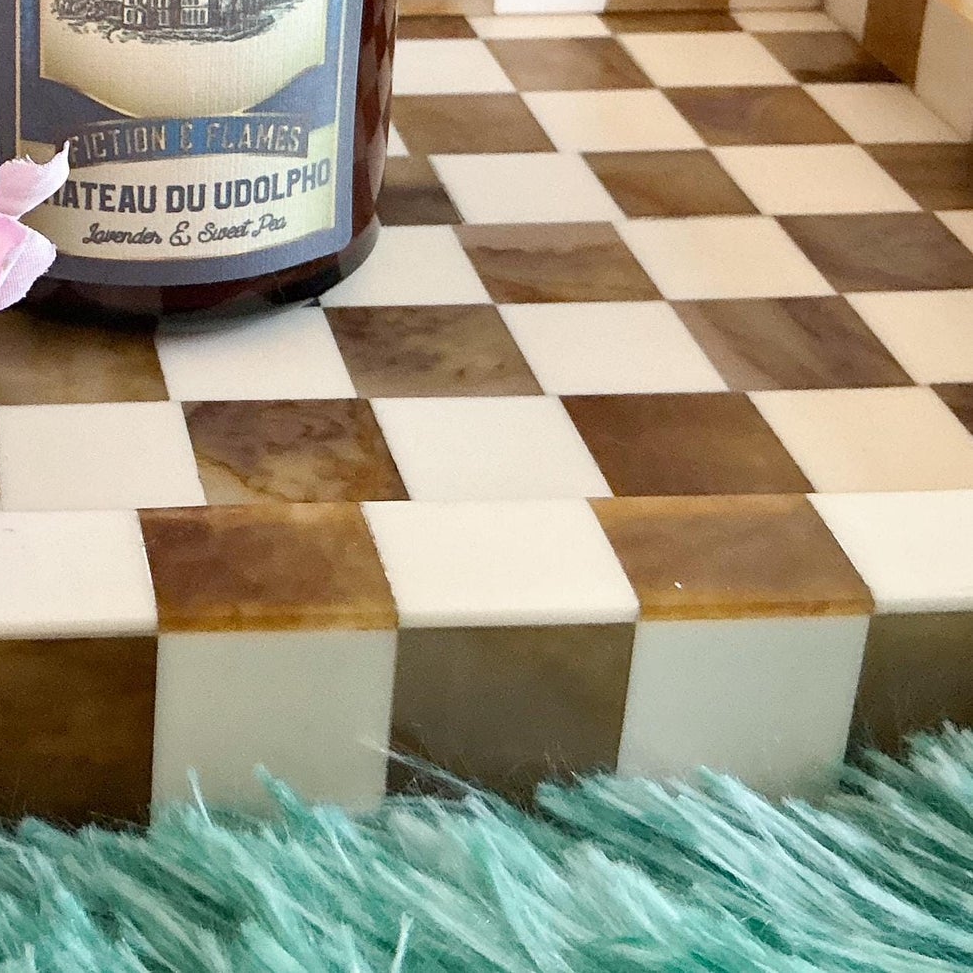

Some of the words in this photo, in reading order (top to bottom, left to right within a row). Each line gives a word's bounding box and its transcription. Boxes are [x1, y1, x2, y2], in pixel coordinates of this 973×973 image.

[68, 124, 166, 164] FICTION
[207, 121, 302, 153] FLAMES
[43, 179, 157, 214] ATEAU
[165, 183, 207, 214] DU
[214, 157, 332, 210] UDOLPHO
[82, 222, 164, 246] Lavender
[198, 217, 251, 244] Sweet
[251, 213, 288, 238] Pea
